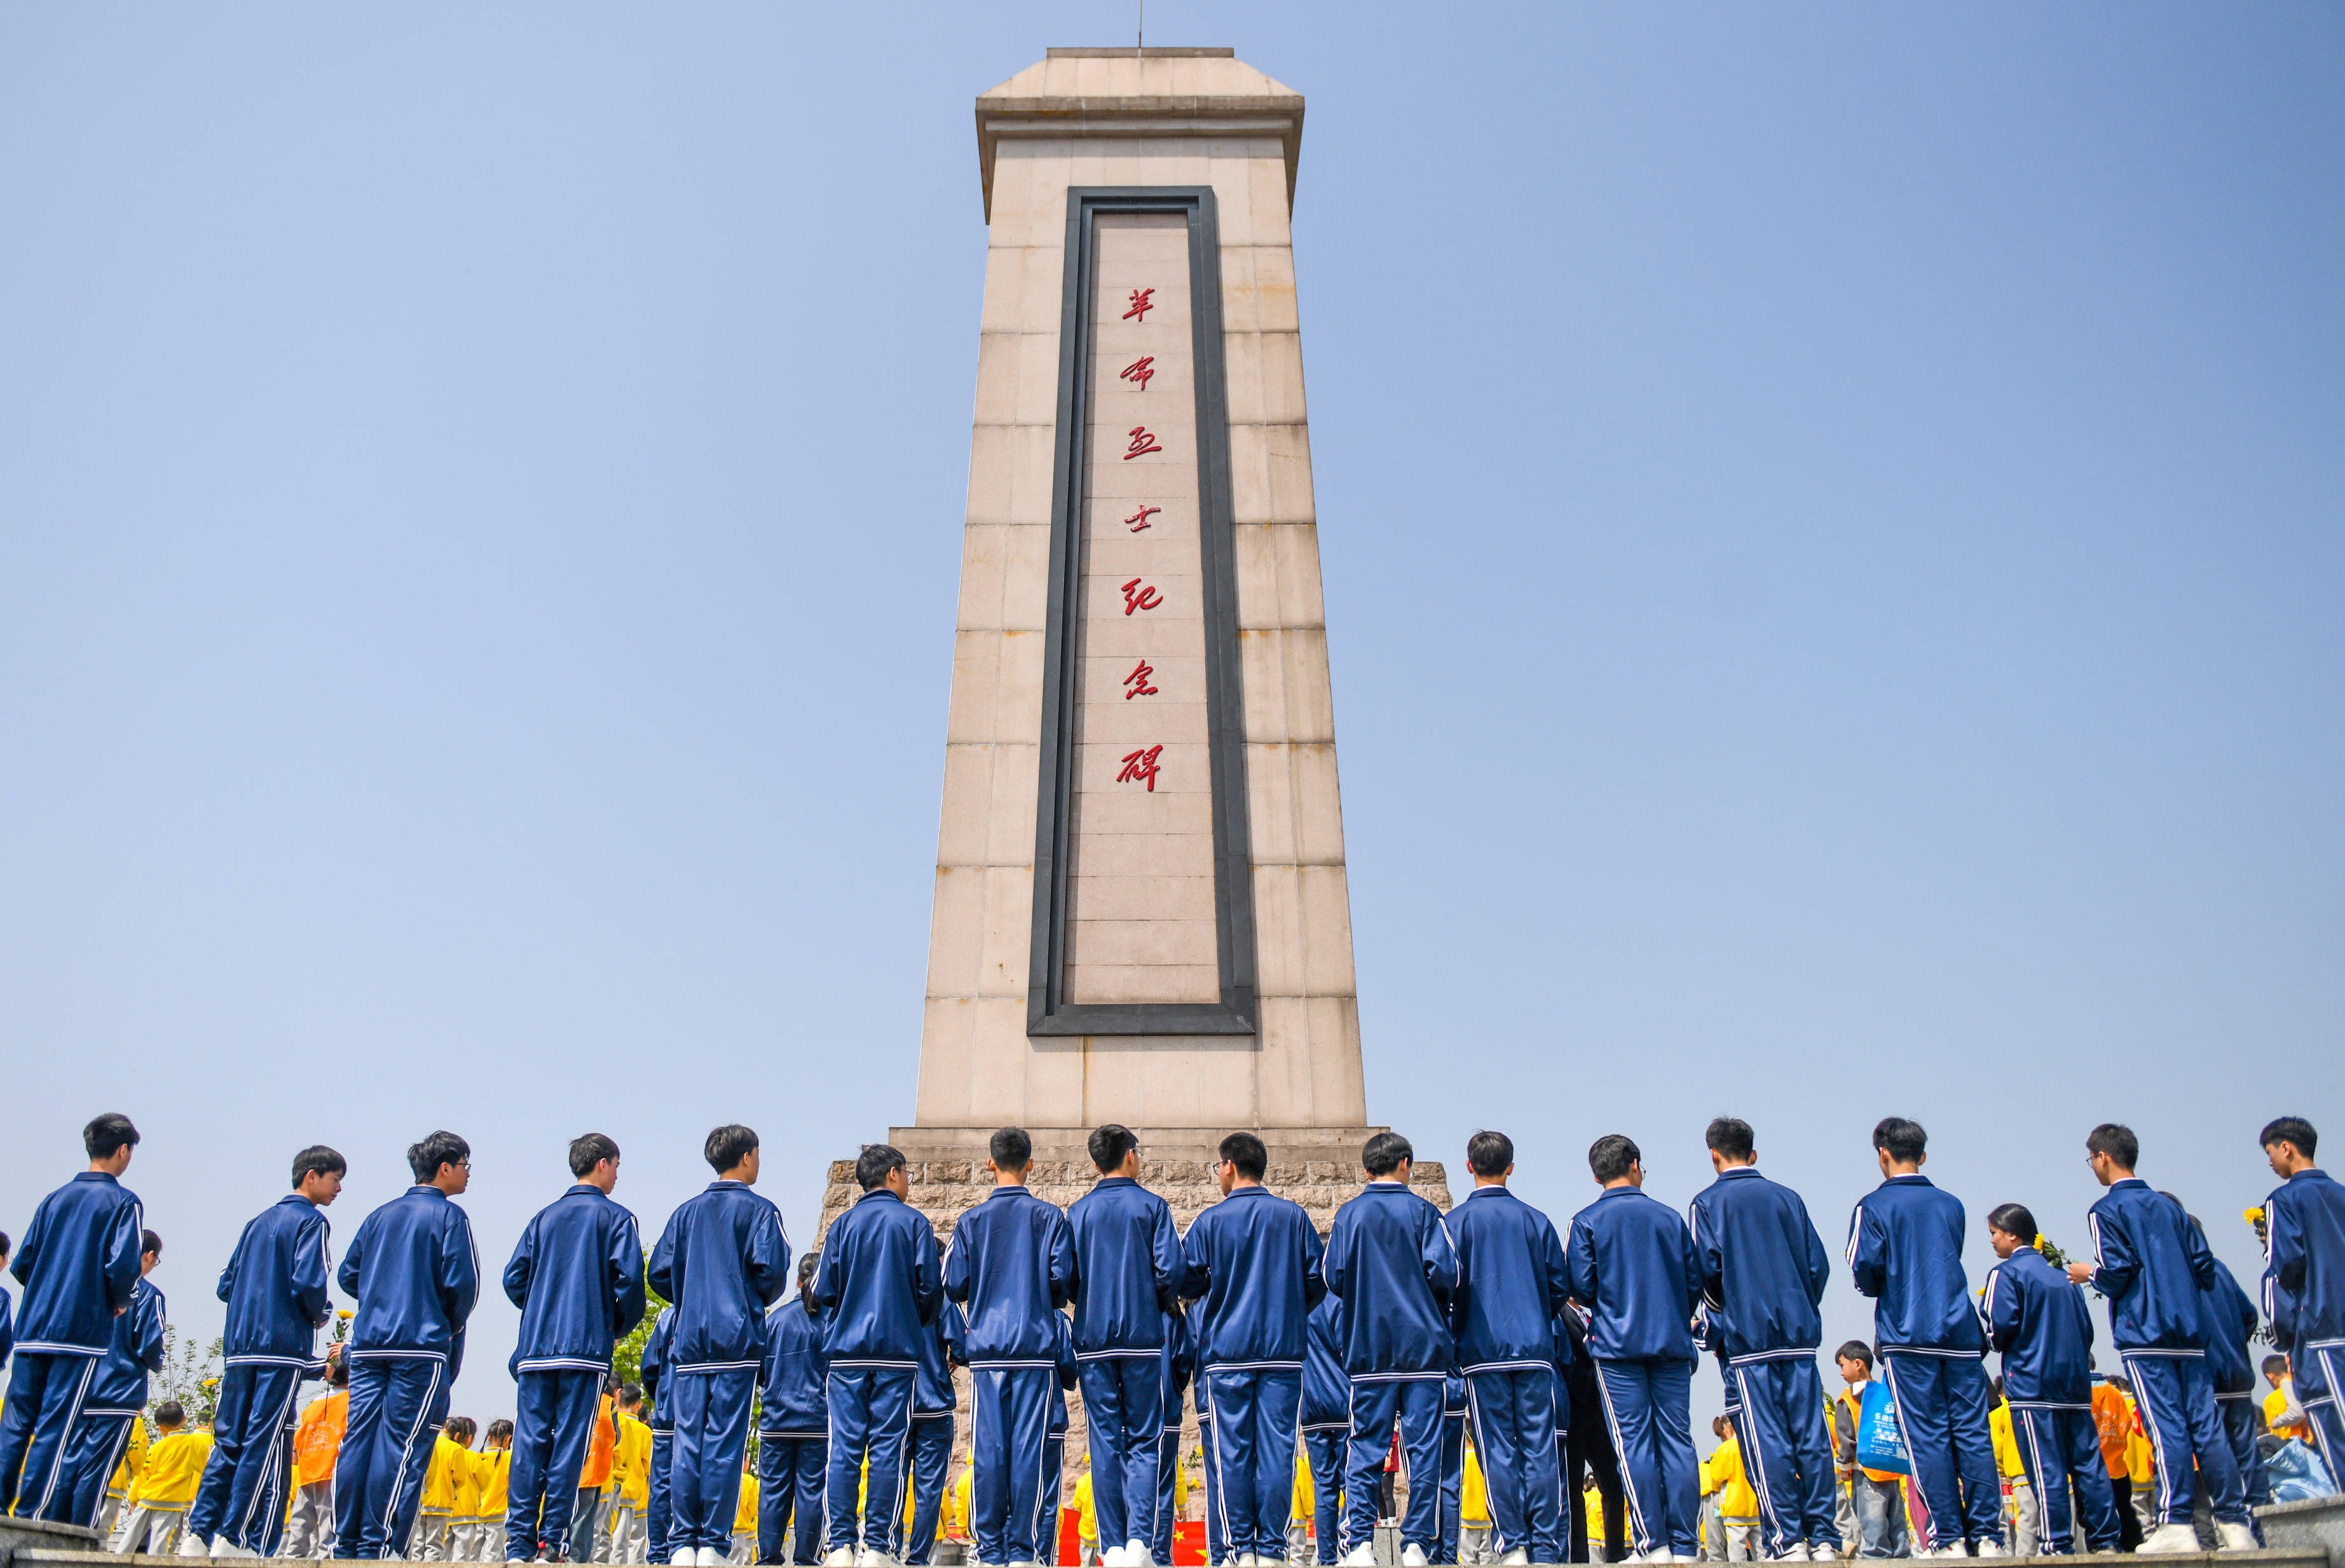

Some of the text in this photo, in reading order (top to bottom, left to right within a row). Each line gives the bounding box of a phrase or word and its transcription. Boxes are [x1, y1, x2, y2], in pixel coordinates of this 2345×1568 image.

[1116, 288, 1163, 791] 革命烈士纪念碑
